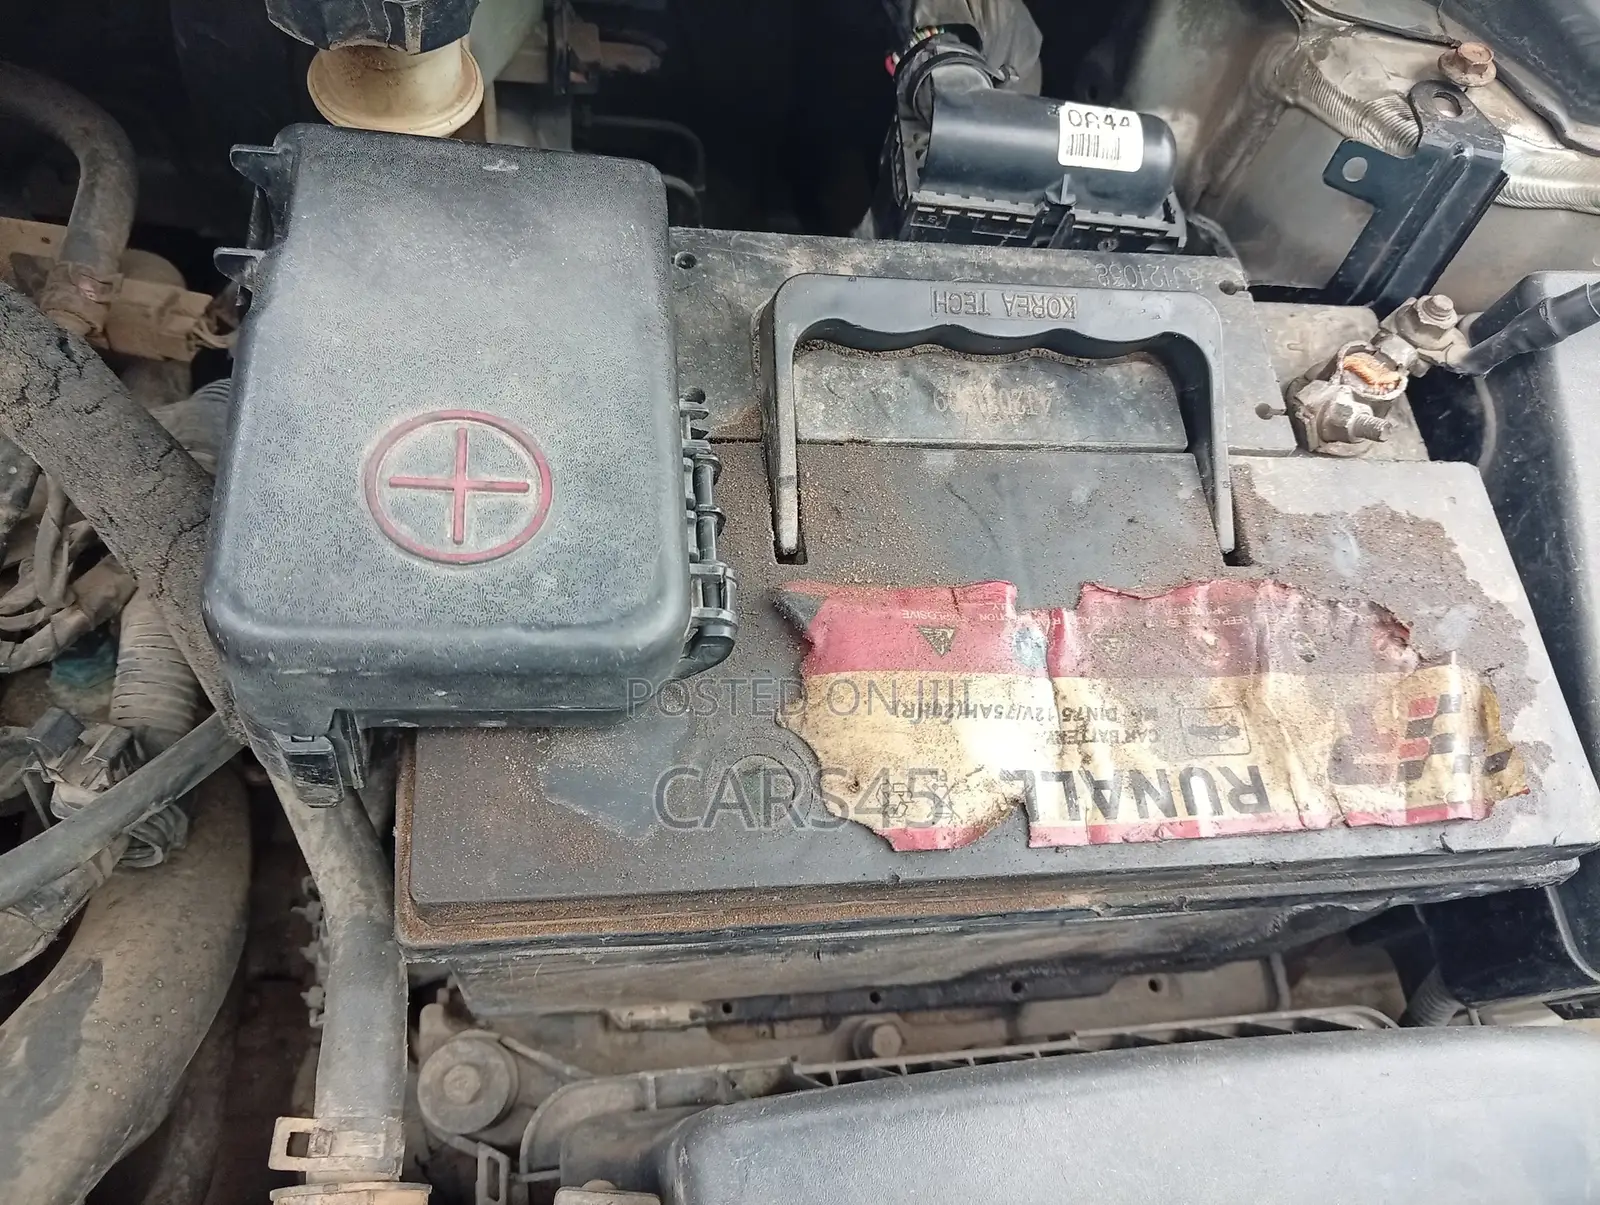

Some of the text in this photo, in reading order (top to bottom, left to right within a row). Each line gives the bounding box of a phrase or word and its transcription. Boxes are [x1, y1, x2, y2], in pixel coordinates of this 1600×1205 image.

[931, 290, 1076, 320] KOREA TECH
[1061, 706, 1118, 722] DIN75
[1125, 728, 1159, 745] CAR
[999, 764, 1272, 824] RUNALL
